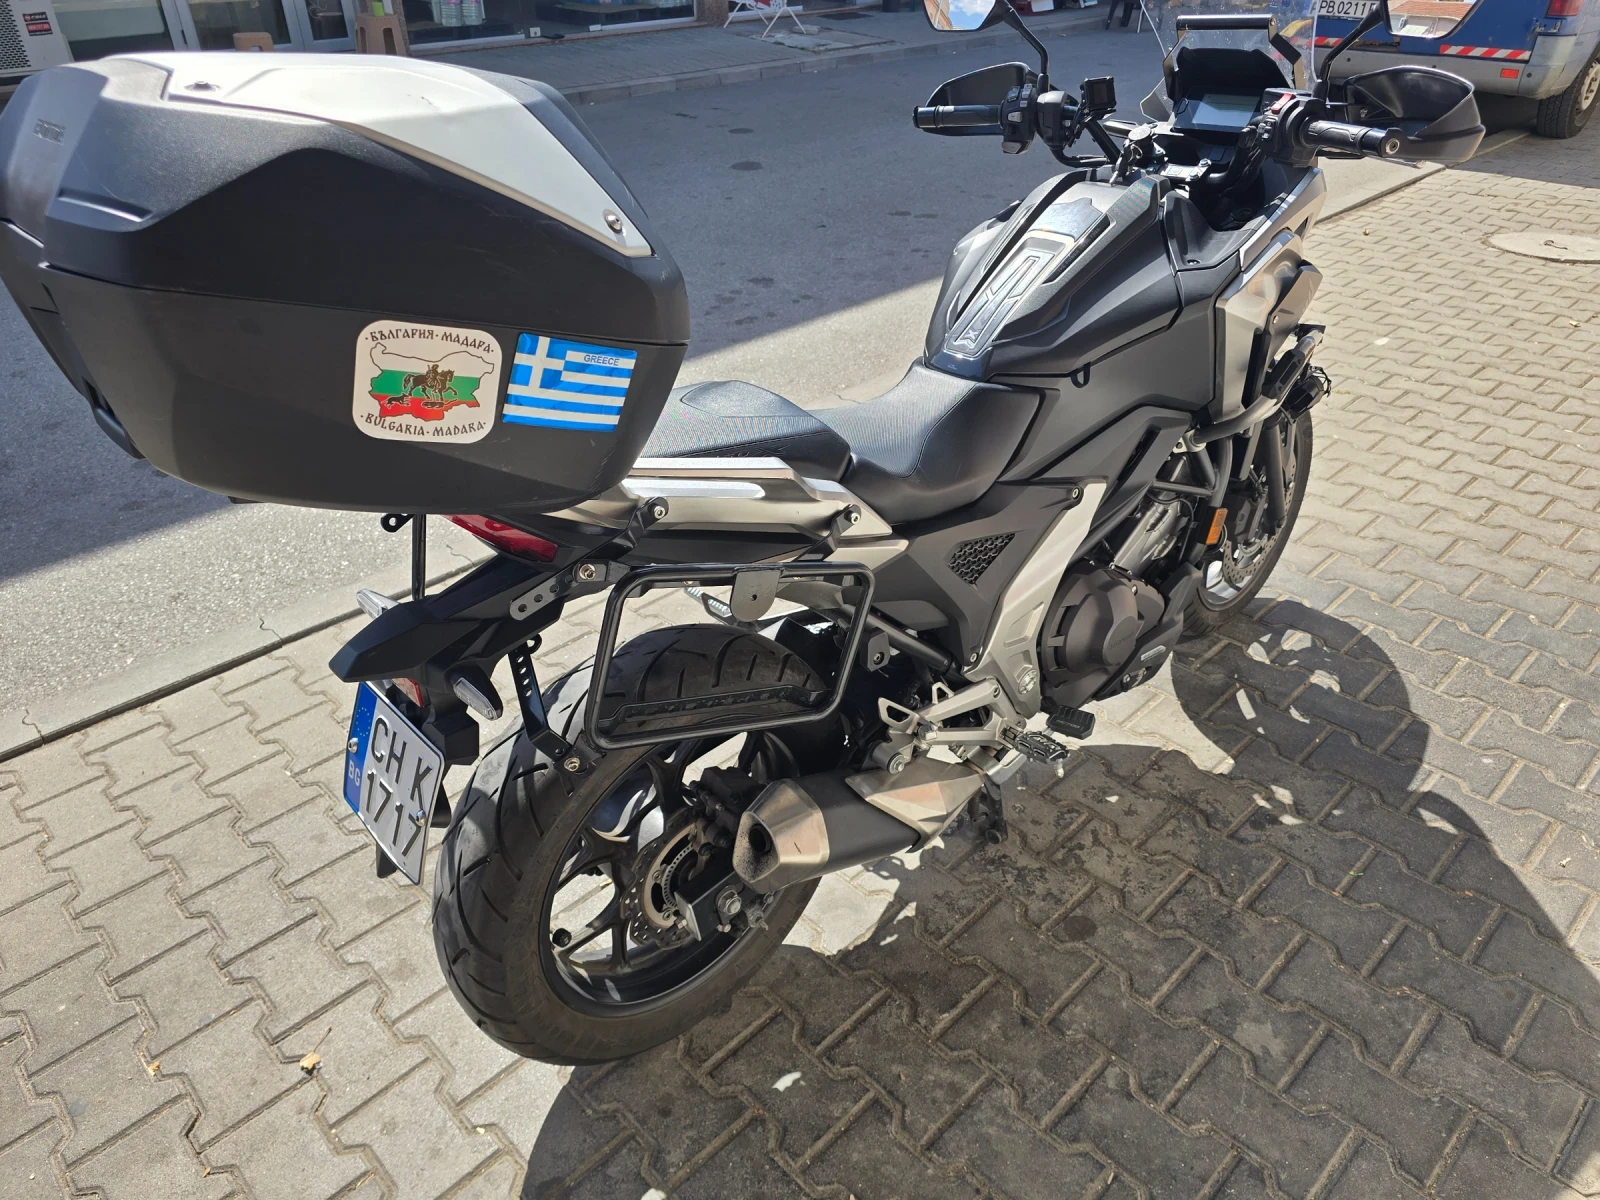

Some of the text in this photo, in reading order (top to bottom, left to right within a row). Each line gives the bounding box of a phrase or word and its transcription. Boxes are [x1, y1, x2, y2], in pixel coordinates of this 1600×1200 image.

[583, 354, 620, 366] GREECE
[365, 412, 484, 437] BULGARIA MADARA
[348, 759, 361, 787] BG
[366, 769, 421, 858] 1717
